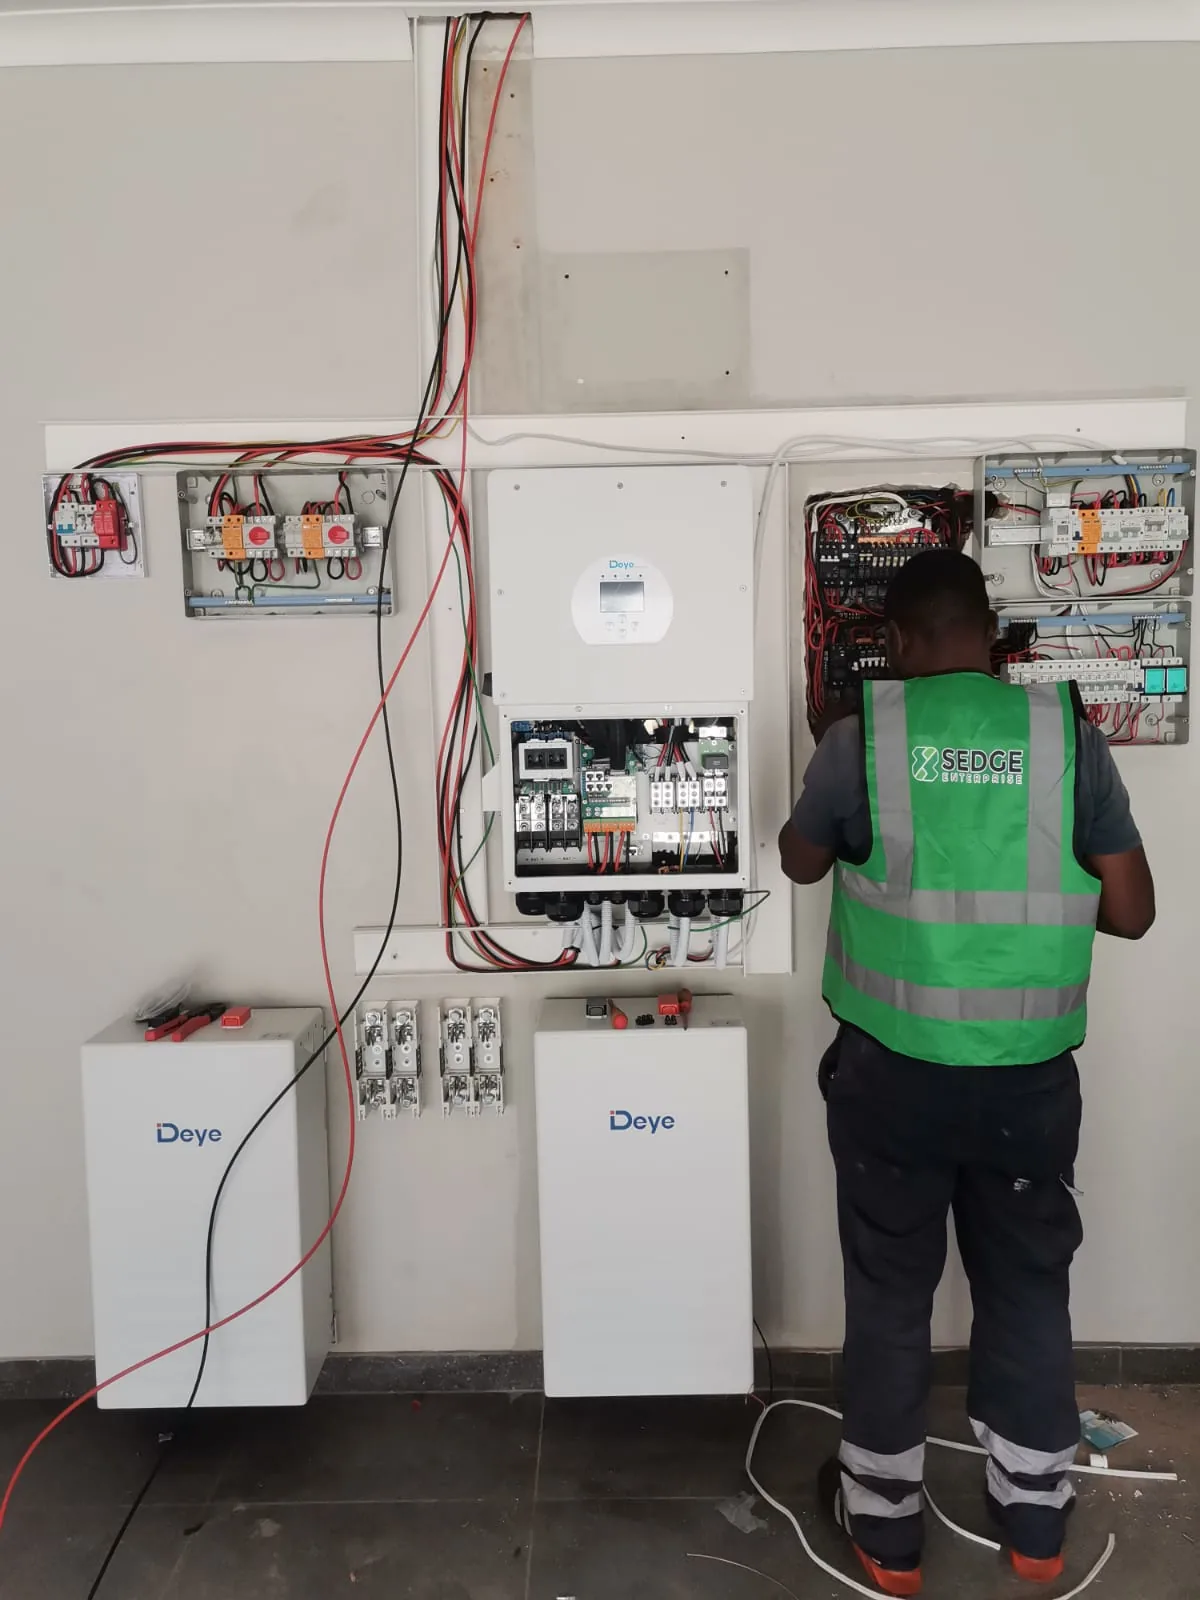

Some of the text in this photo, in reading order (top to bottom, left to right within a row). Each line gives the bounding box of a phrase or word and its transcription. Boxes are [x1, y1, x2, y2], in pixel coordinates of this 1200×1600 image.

[941, 747, 1024, 774] SEDGE
[941, 772, 1023, 785] ENTERPRISE
[609, 1110, 676, 1134] Deye
[156, 1122, 222, 1147] Deye
